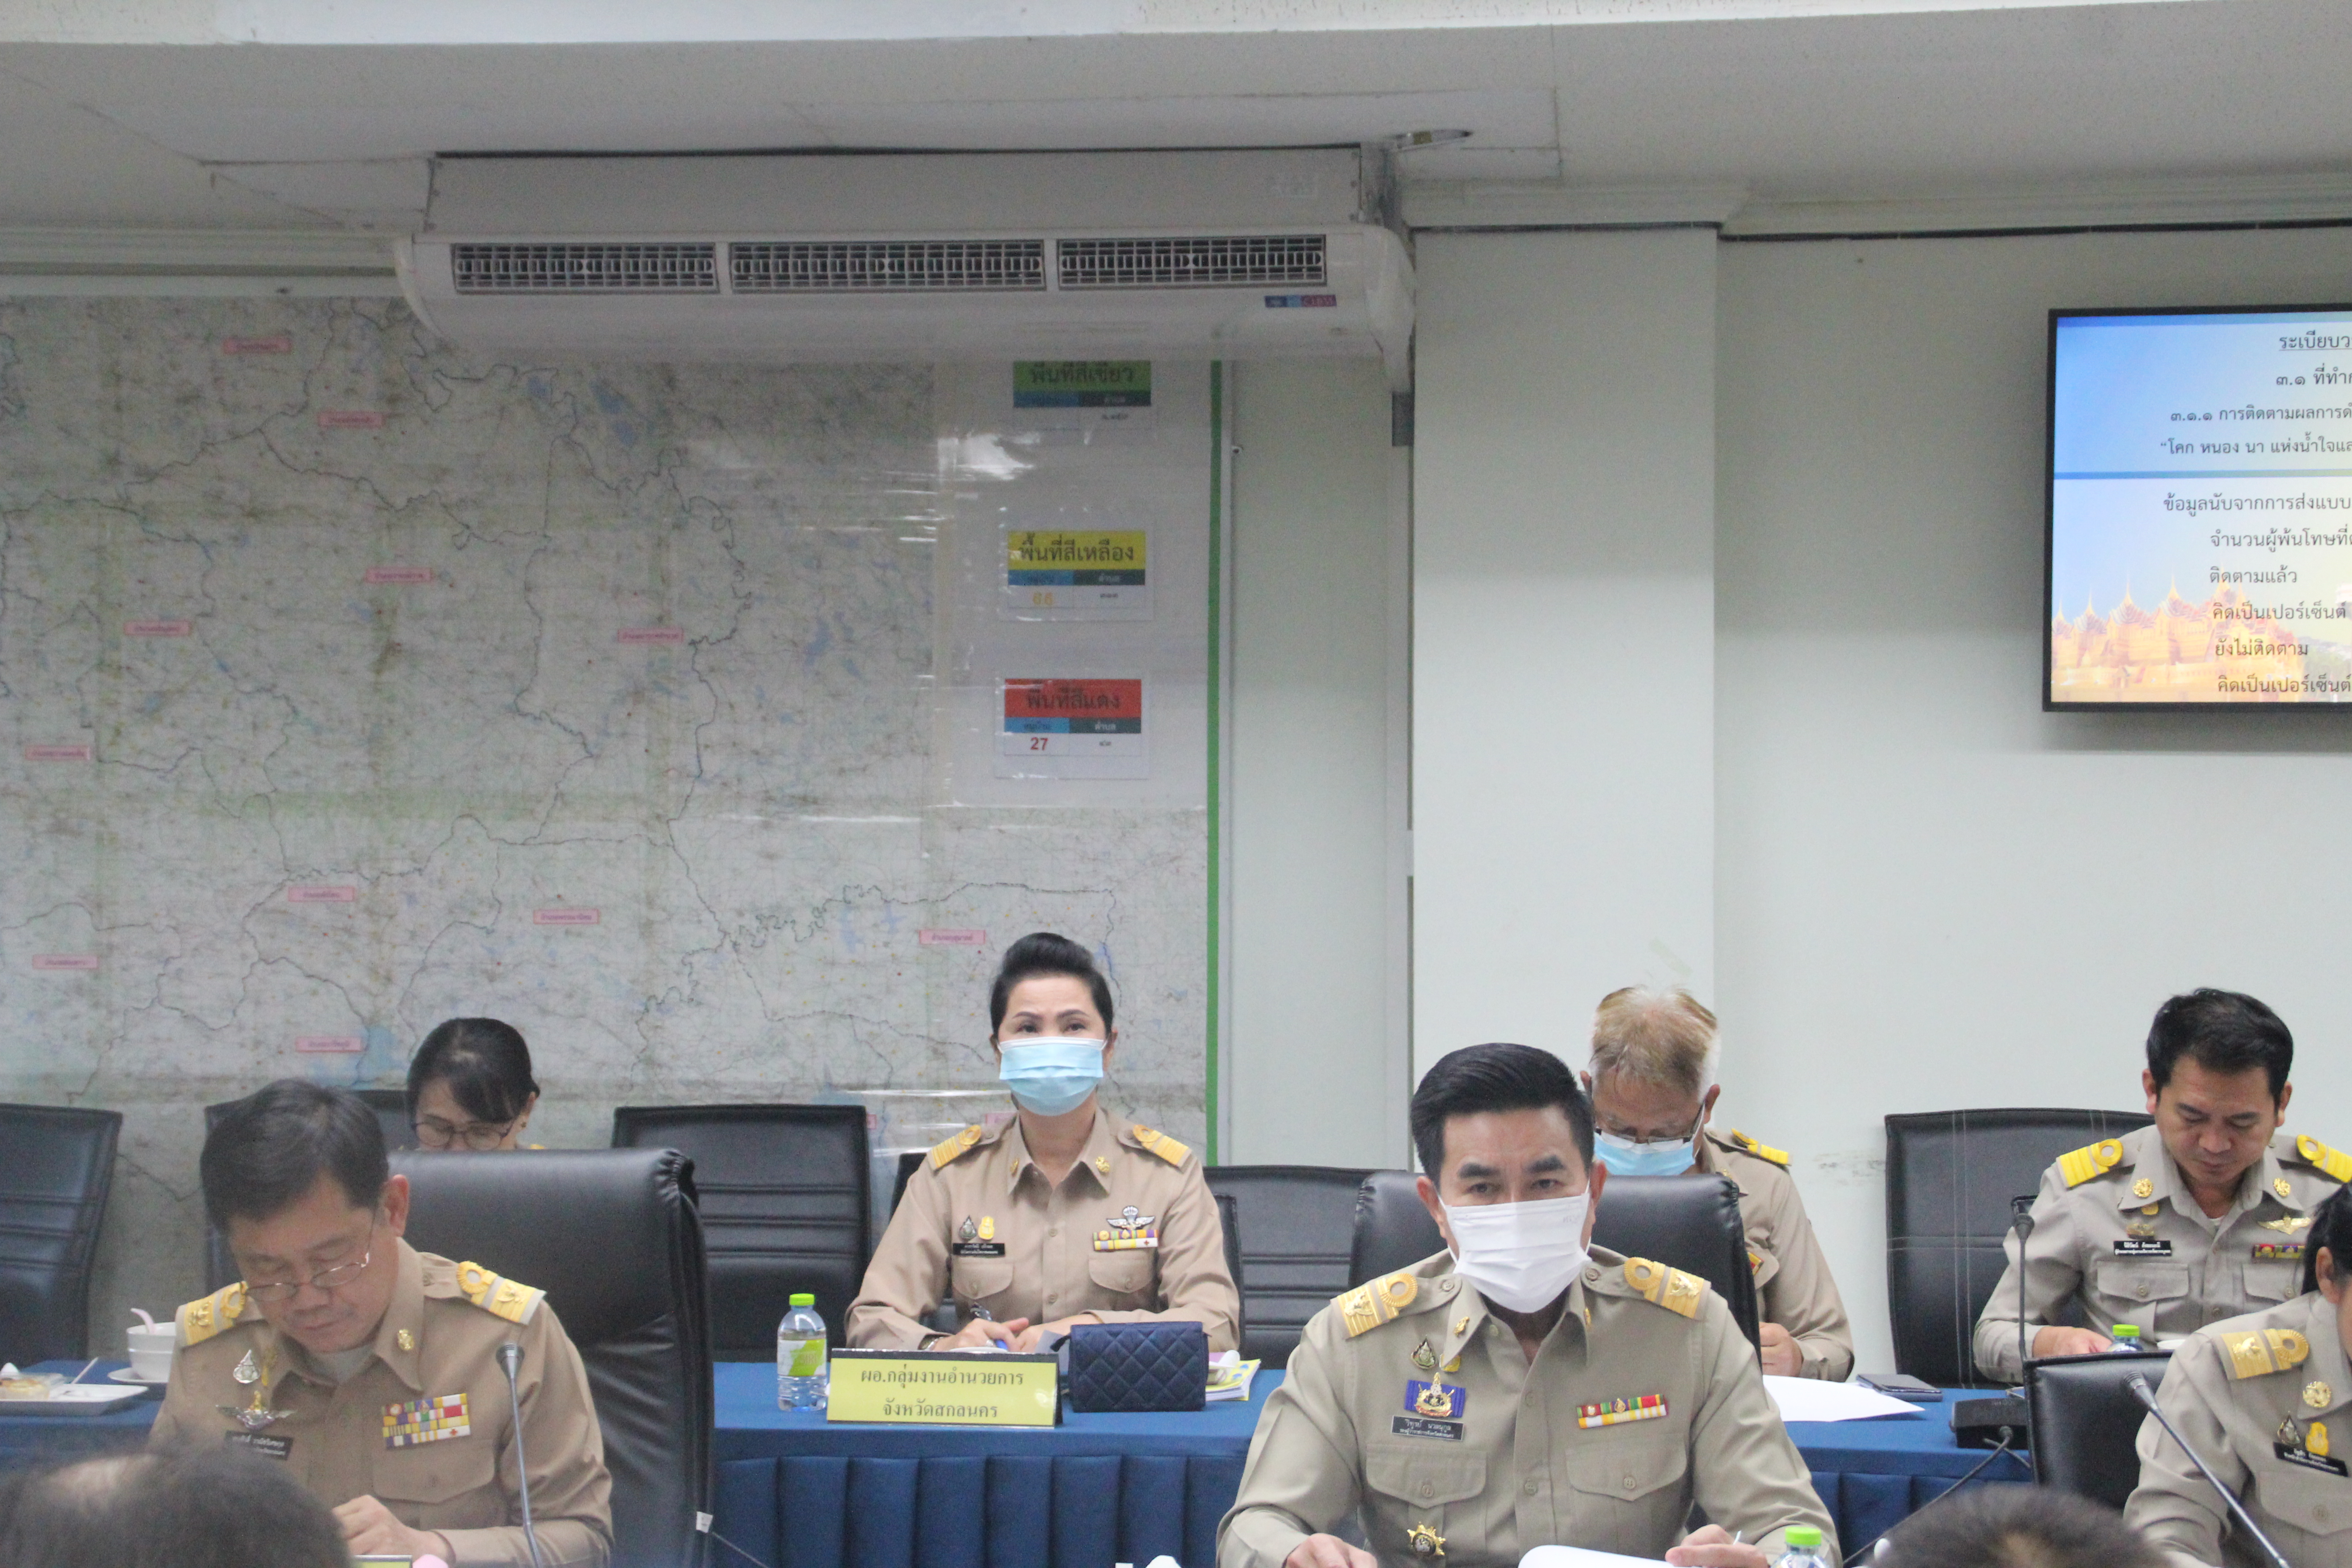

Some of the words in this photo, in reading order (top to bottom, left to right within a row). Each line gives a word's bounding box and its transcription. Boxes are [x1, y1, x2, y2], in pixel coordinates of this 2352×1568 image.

[2279, 329, 2352, 348] ระเบียบว
[2276, 376, 2305, 385] ๓.๑
[2171, 412, 2213, 421] ๓.๑.๑
[2200, 442, 2239, 454] หนอง
[2245, 442, 2264, 453] นา
[2163, 492, 2351, 517] ข้อมูลนับจากการส่งแบบ
[1019, 532, 1134, 561] พื้นที่สีเหลือง
[2210, 564, 2298, 583] ติดตามแล้ว
[2213, 600, 2347, 620] คิดเป็นเปอร์เซ็นต์
[2215, 637, 2308, 656] ยังไม่ติดตาม
[2218, 673, 2352, 692] คิดเป็นเปอร์เซ็นต์
[1030, 737, 1049, 750] 27
[861, 1363, 1024, 1388] ผอ.กลุ่มงานอำนวยการ
[882, 1397, 998, 1418] จังหวัดสกลนคร
